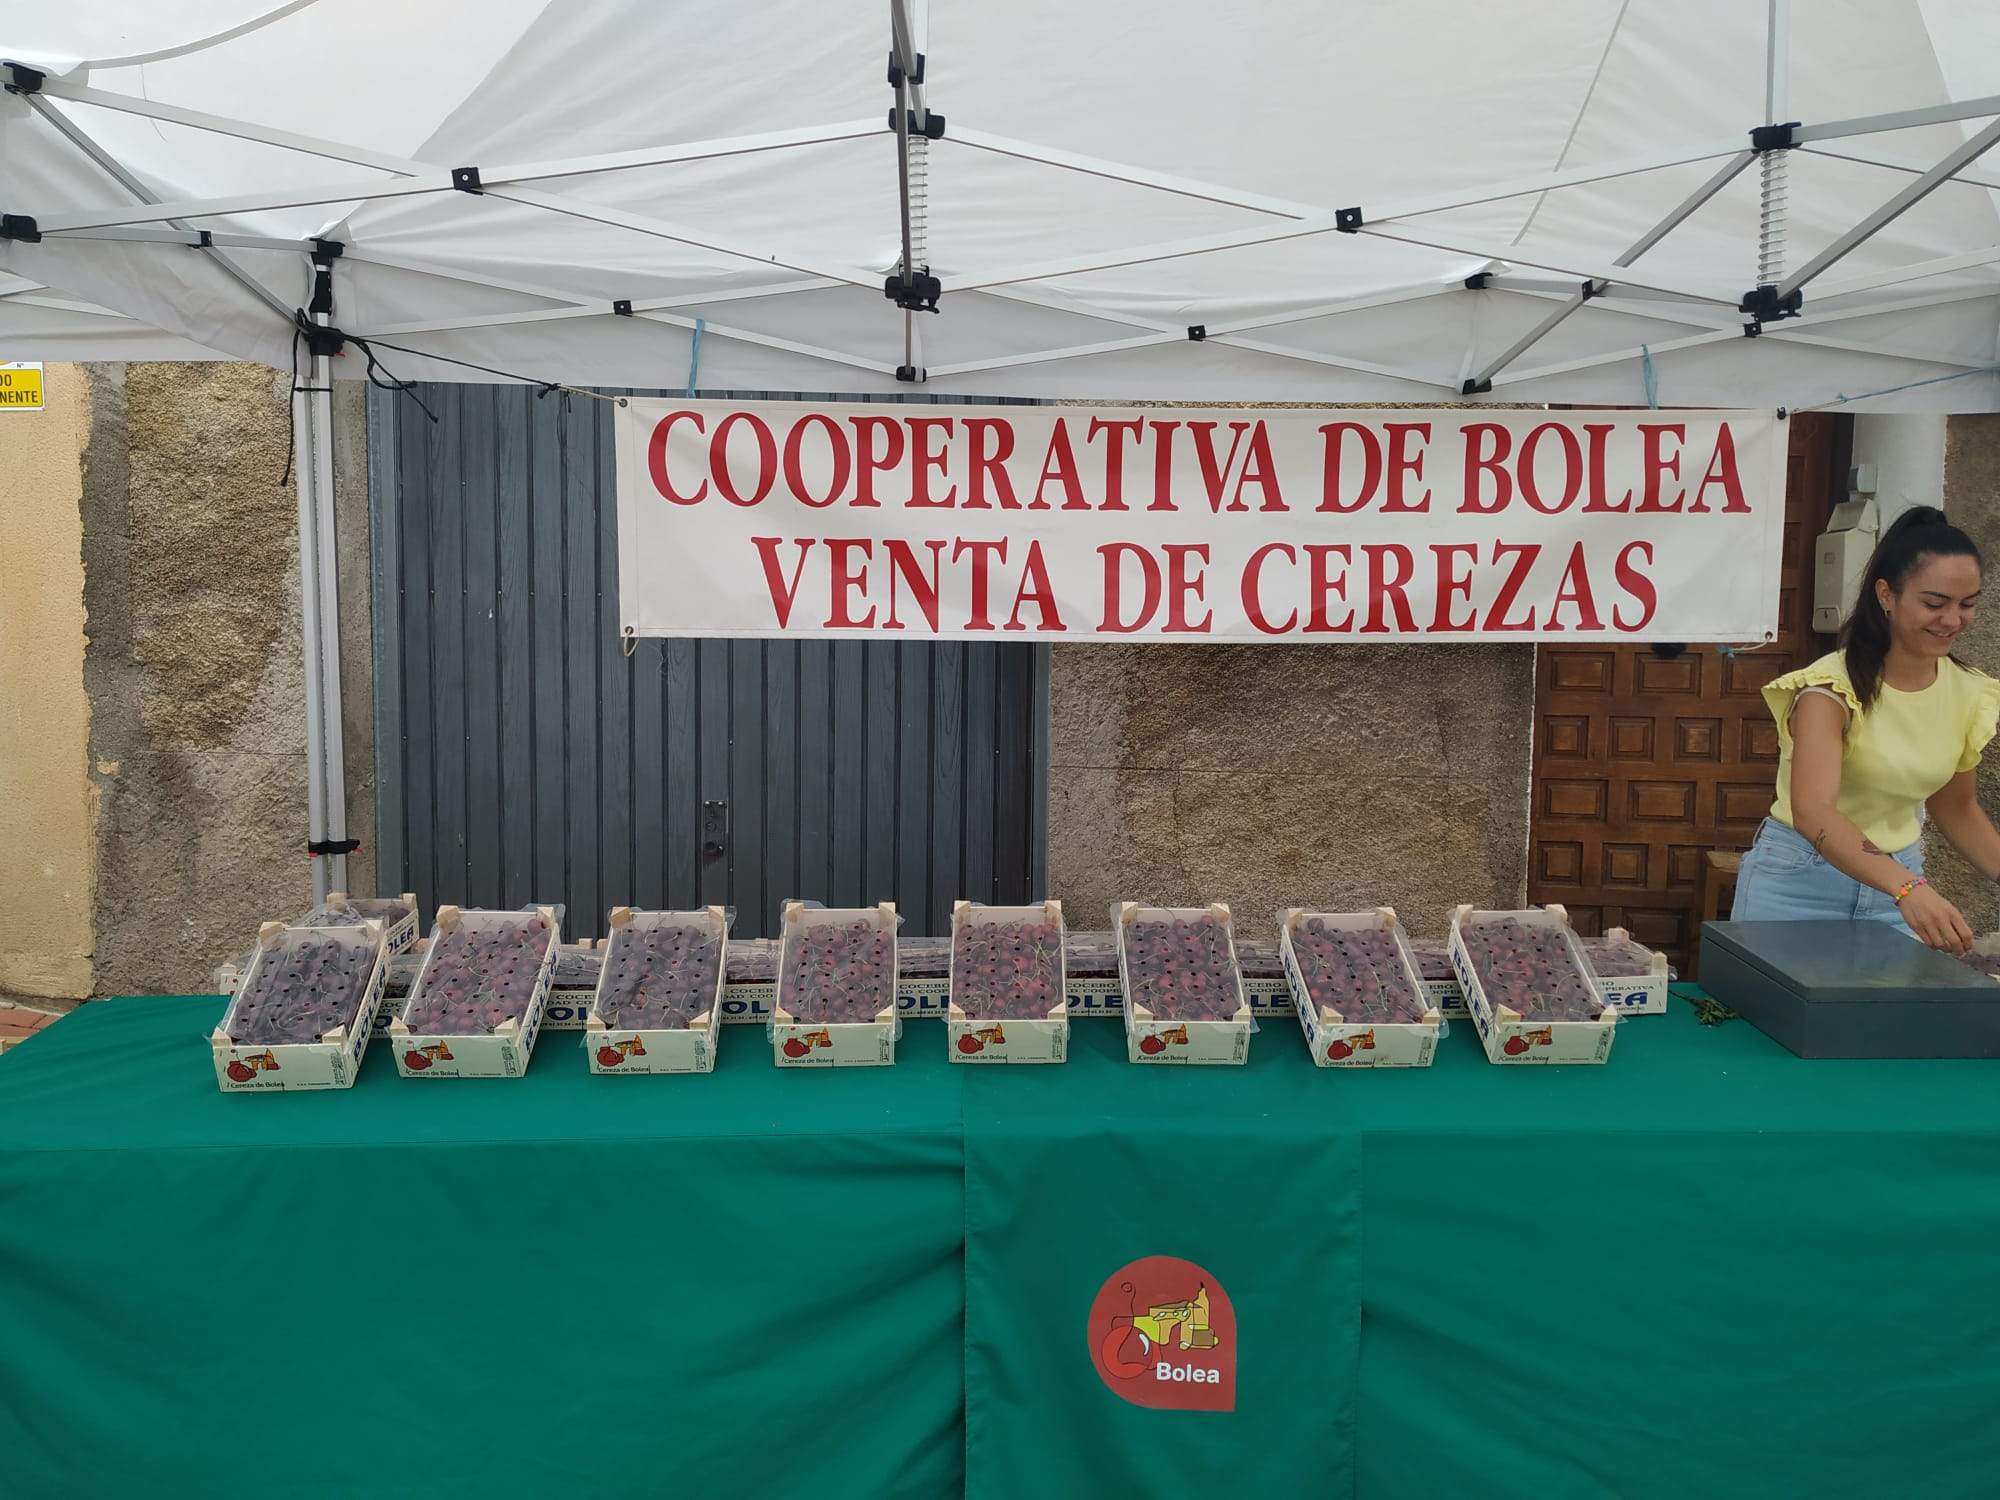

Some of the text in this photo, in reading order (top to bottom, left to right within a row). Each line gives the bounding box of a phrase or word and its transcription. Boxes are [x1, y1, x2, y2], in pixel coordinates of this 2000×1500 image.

[648, 411, 1750, 514] COOPERATIVA DE BOLEA
[751, 537, 1656, 635] VENTA DE CEREZAS
[1156, 1362, 1221, 1384] Bolea
